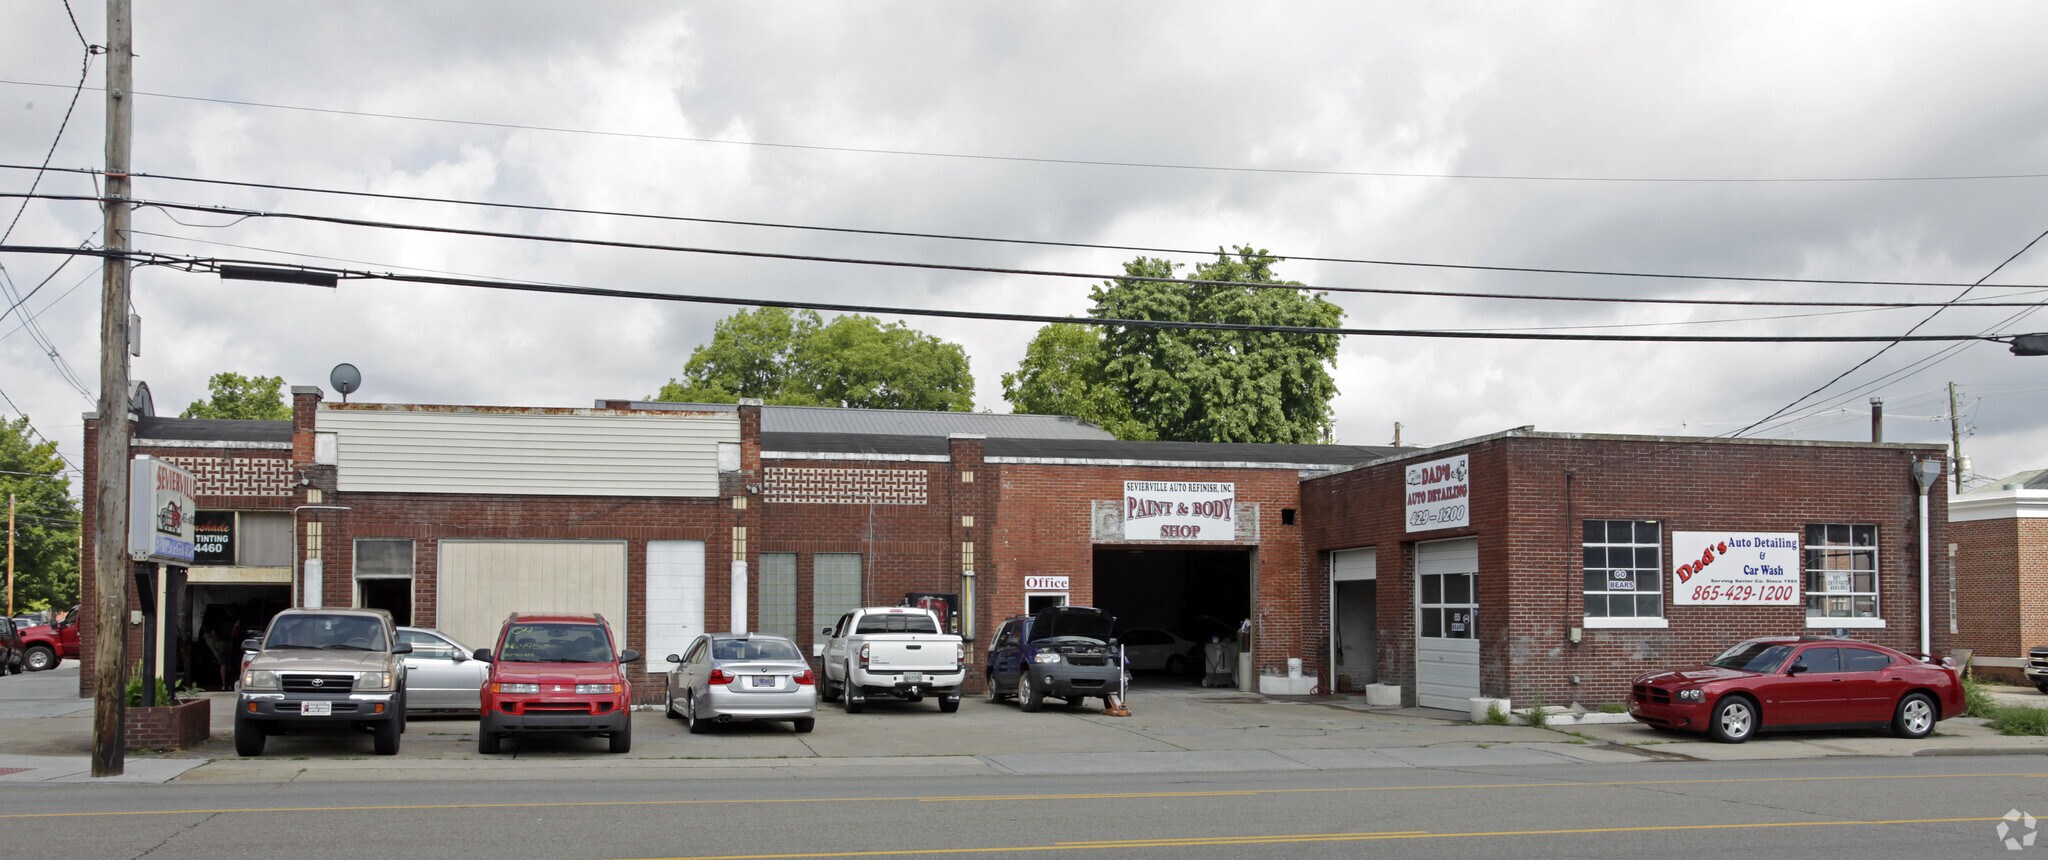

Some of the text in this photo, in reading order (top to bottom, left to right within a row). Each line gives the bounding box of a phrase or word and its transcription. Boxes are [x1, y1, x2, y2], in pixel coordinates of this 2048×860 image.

[1421, 464, 1451, 485] DAD'S
[156, 465, 196, 501] SEVIERVILLE
[1126, 482, 1233, 494] SEVIERVILLE AUTO REFINISH, INC.
[1407, 484, 1467, 506] AUTO DETAILING
[1126, 496, 1233, 522] PAINT & BODY
[1160, 525, 1200, 539] SHOP
[194, 543, 223, 553] 4460
[1728, 537, 1797, 551] Auto Detailing
[1676, 541, 1727, 584] Dad's
[1759, 551, 1766, 560] &
[1614, 570, 1627, 579] GO
[1743, 564, 1784, 575] Car Wash
[1026, 577, 1068, 588] Office
[1610, 581, 1634, 589] BEARS
[1692, 585, 1793, 601] 865-429-1200
